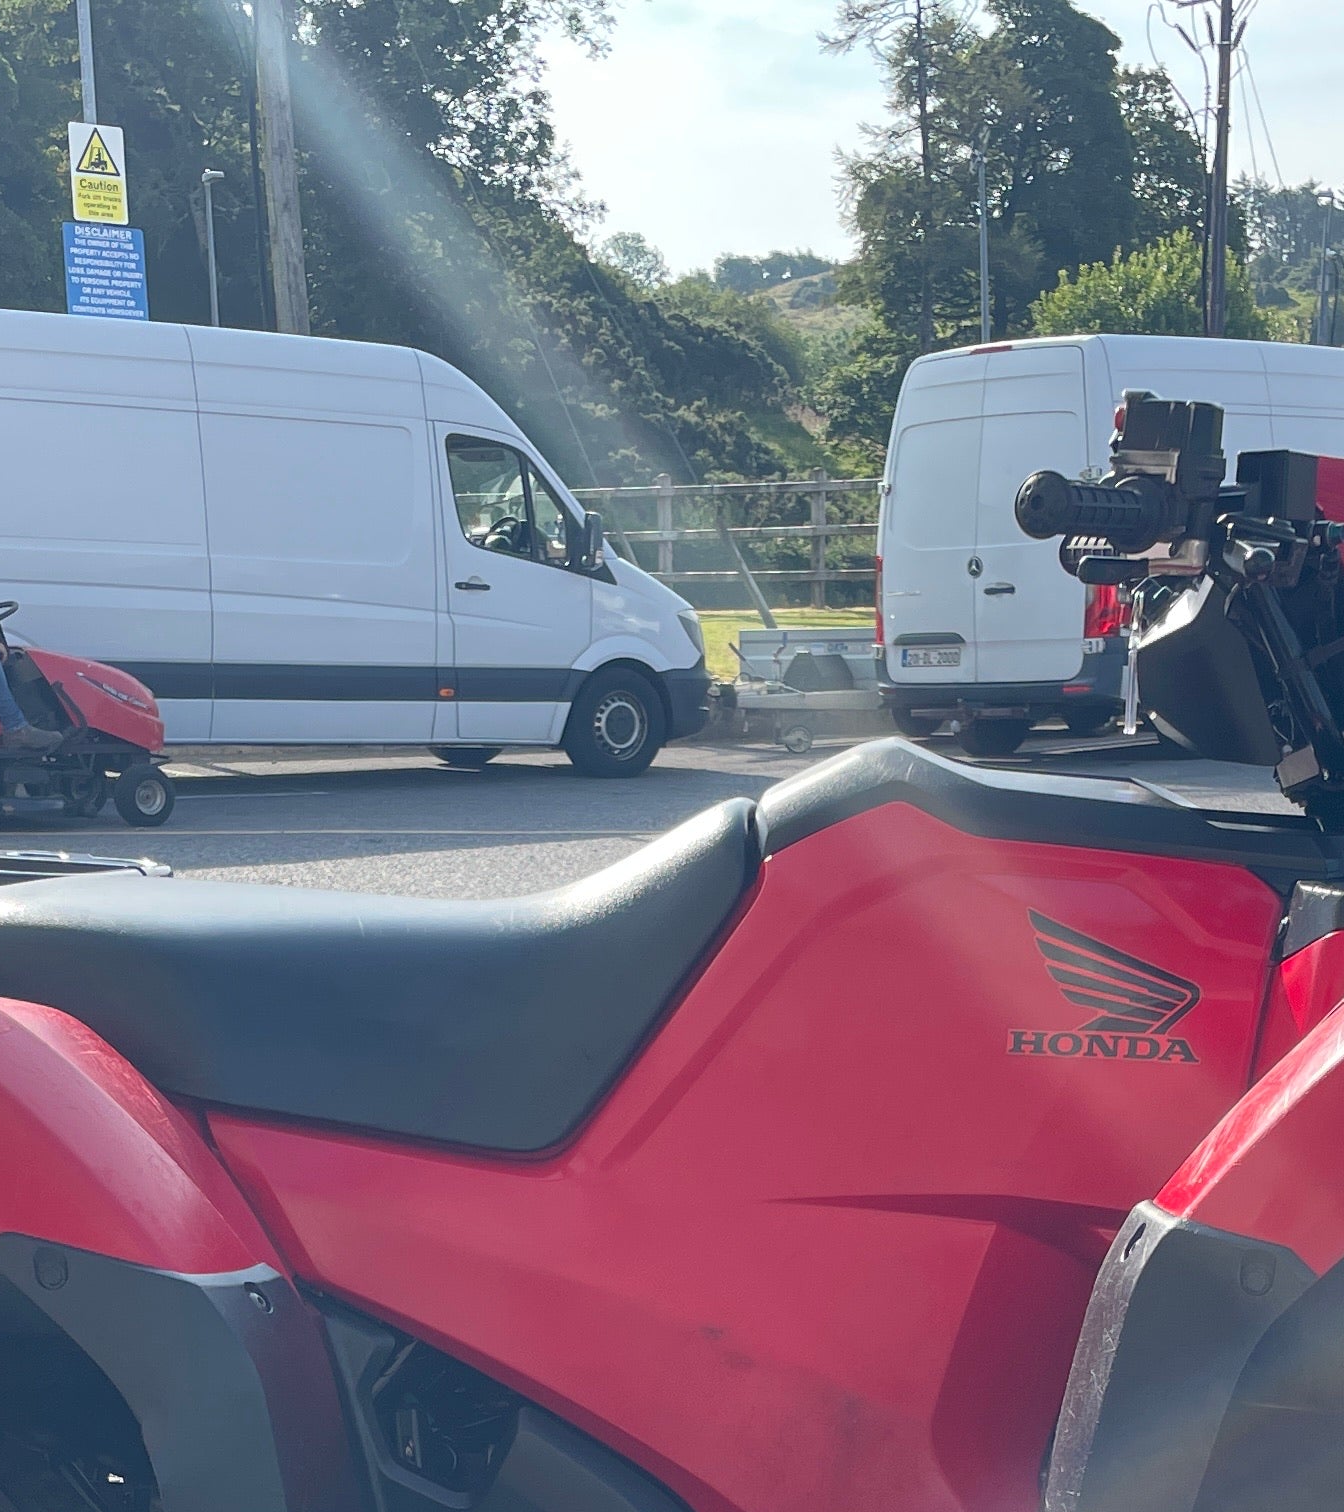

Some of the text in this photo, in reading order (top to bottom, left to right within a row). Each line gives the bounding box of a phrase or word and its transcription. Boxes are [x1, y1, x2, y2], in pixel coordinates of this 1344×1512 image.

[79, 179, 119, 192] Caution
[74, 226, 132, 240] DISCLAIMER
[74, 238, 86, 246] THE
[111, 241, 119, 249] OF
[69, 247, 101, 256] PROPERTY
[124, 262, 137, 270] FOR
[71, 276, 80, 284] TO
[111, 280, 142, 289] PROPERTY
[92, 288, 105, 296] ANY
[80, 296, 90, 304] ITS
[1008, 1030, 1199, 1064] HONDA
